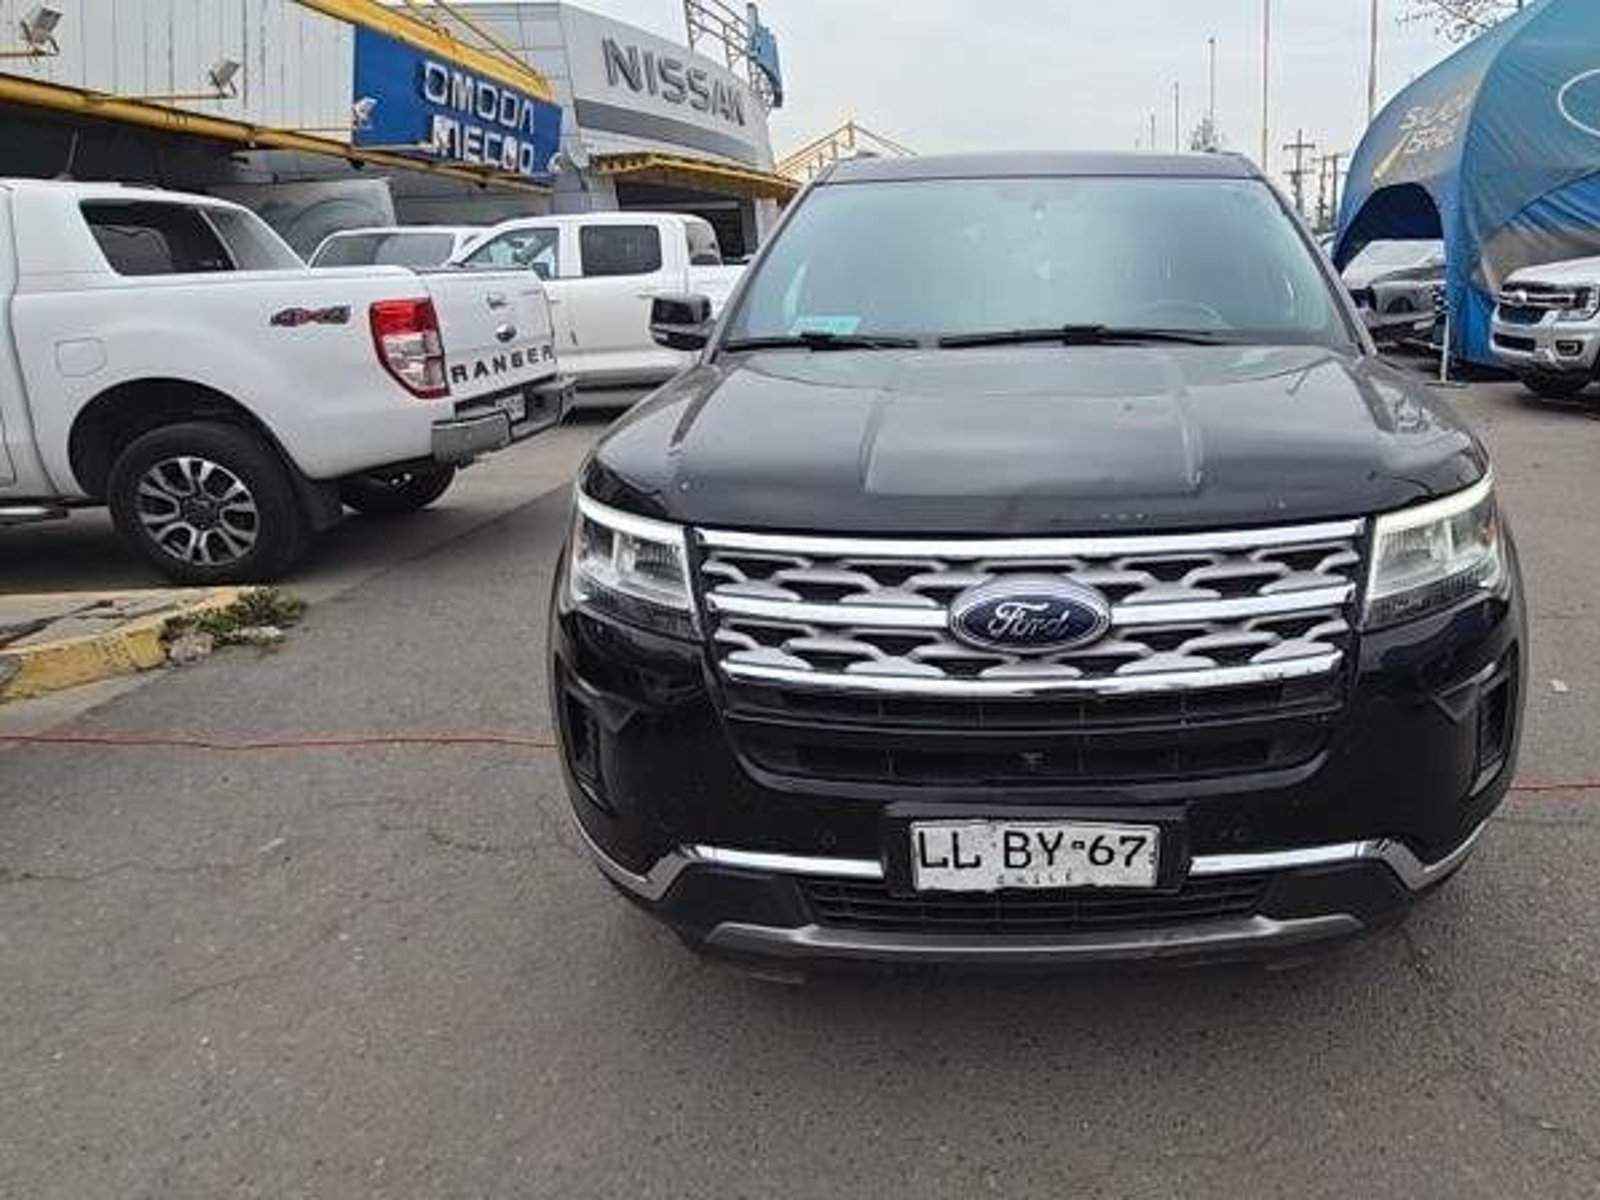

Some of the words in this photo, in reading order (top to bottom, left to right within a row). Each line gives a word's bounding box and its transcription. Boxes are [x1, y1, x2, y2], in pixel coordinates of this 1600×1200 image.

[424, 60, 535, 135] OMODA
[602, 37, 745, 126] NISSAN
[450, 345, 553, 383] RANGER
[987, 602, 1070, 638] Ford
[918, 831, 981, 869] LL
